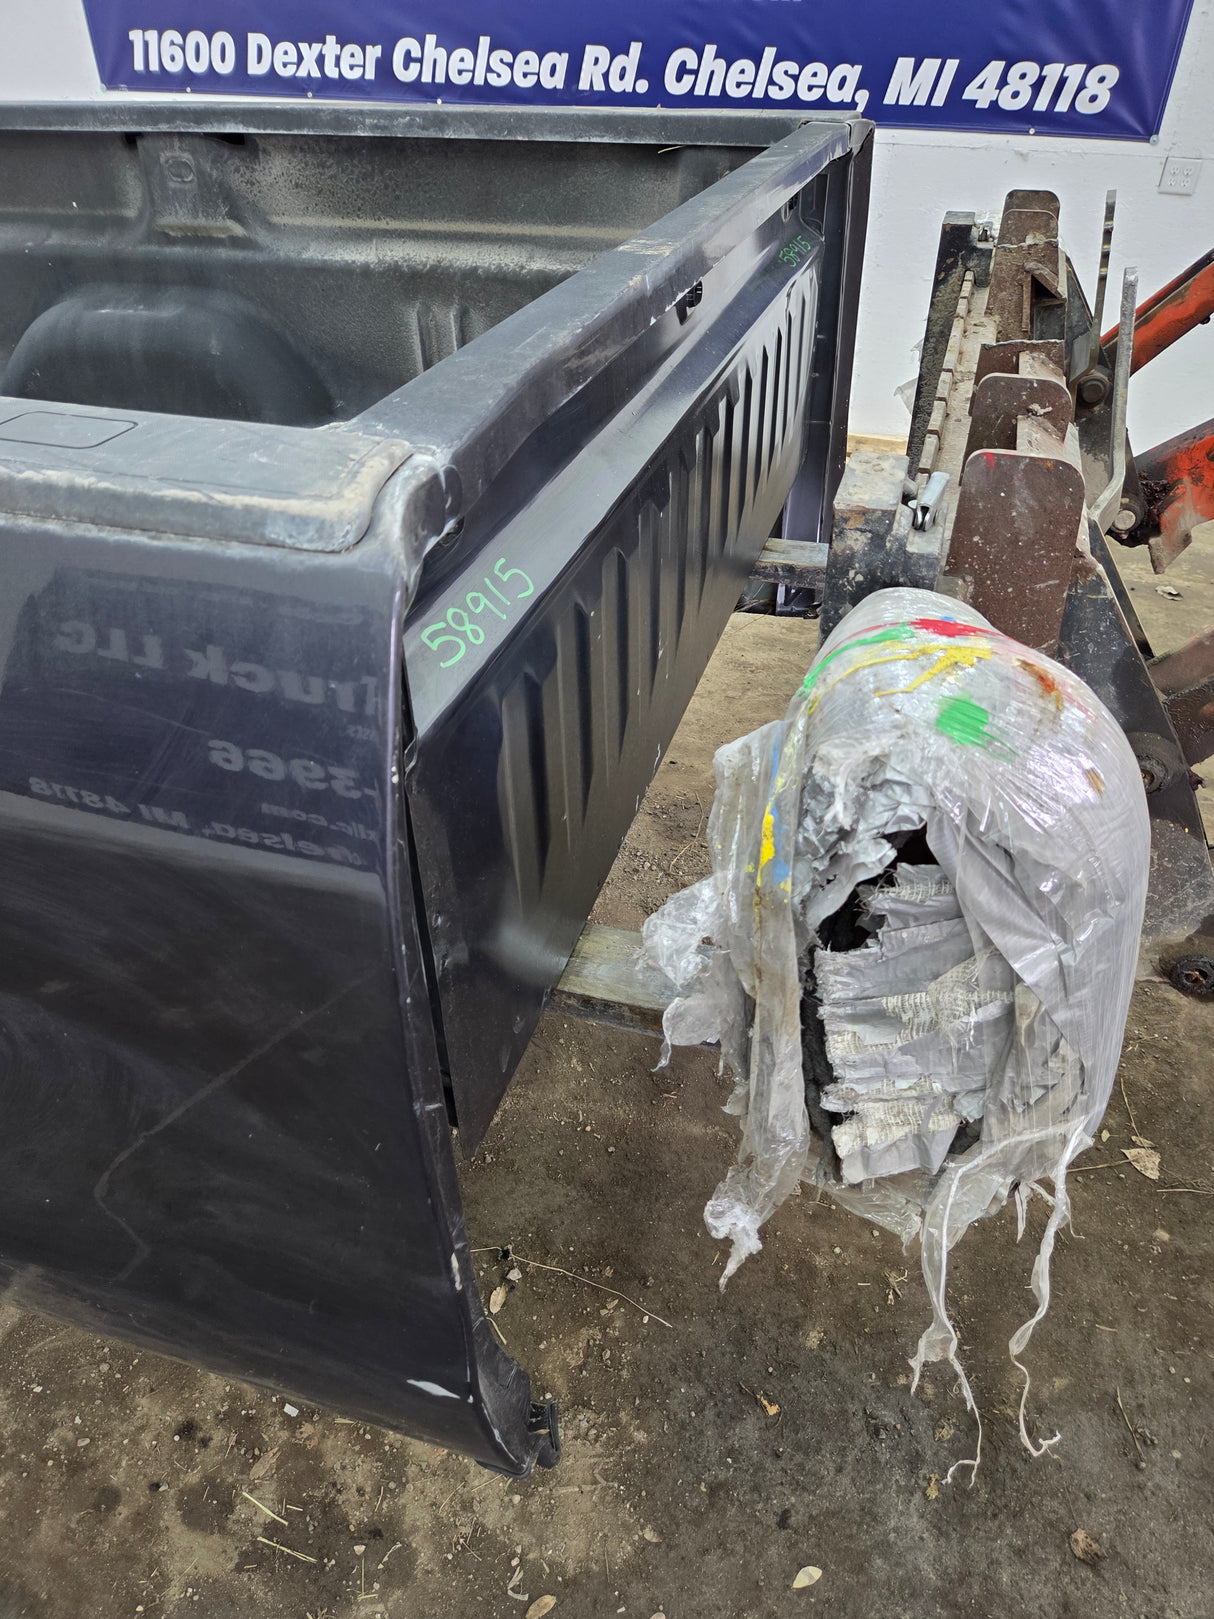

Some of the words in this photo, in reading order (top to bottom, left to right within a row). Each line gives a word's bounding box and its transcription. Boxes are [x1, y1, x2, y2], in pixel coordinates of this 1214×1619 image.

[128, 29, 235, 75] 11600
[246, 32, 381, 80] Dexter
[392, 34, 568, 90] Chelsea
[578, 41, 649, 94] Rd.
[664, 43, 870, 111] Chelsea,
[883, 56, 960, 107] MI
[962, 60, 1120, 115] 48118
[779, 235, 811, 268] 58915
[421, 557, 534, 669] 58915
